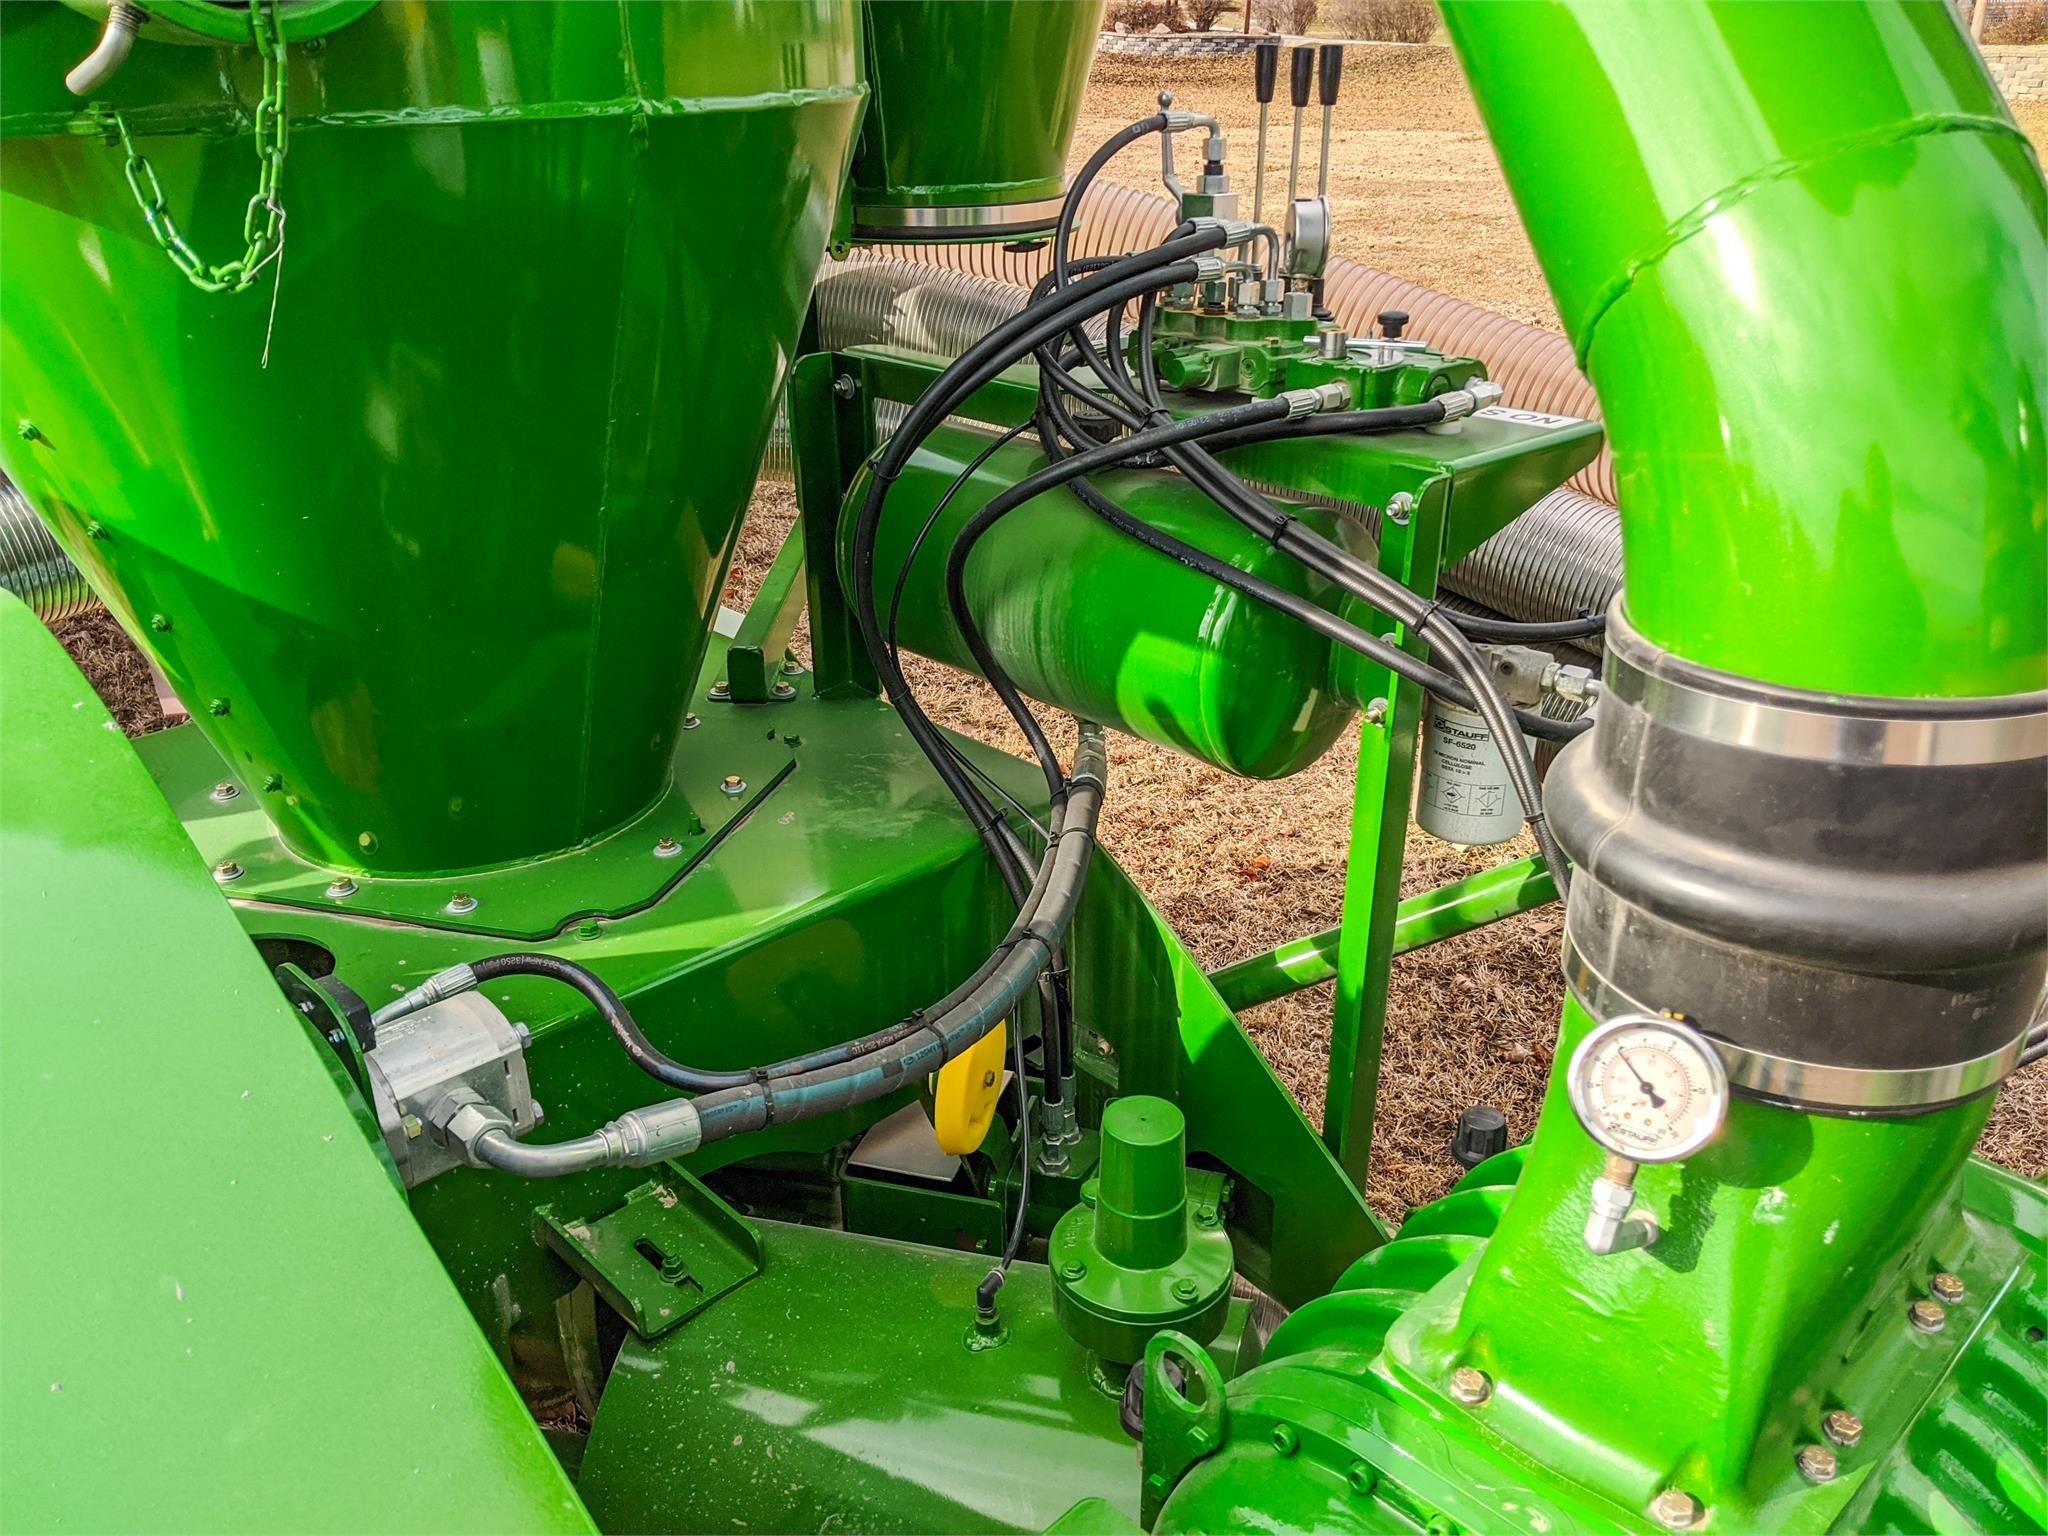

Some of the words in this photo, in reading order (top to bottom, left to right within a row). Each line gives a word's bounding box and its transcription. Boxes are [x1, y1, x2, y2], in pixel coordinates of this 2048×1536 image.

[1446, 726, 1488, 740] STAUFF
[1443, 737, 1476, 750] SF-6520
[1441, 759, 1472, 770] CELLULOSE
